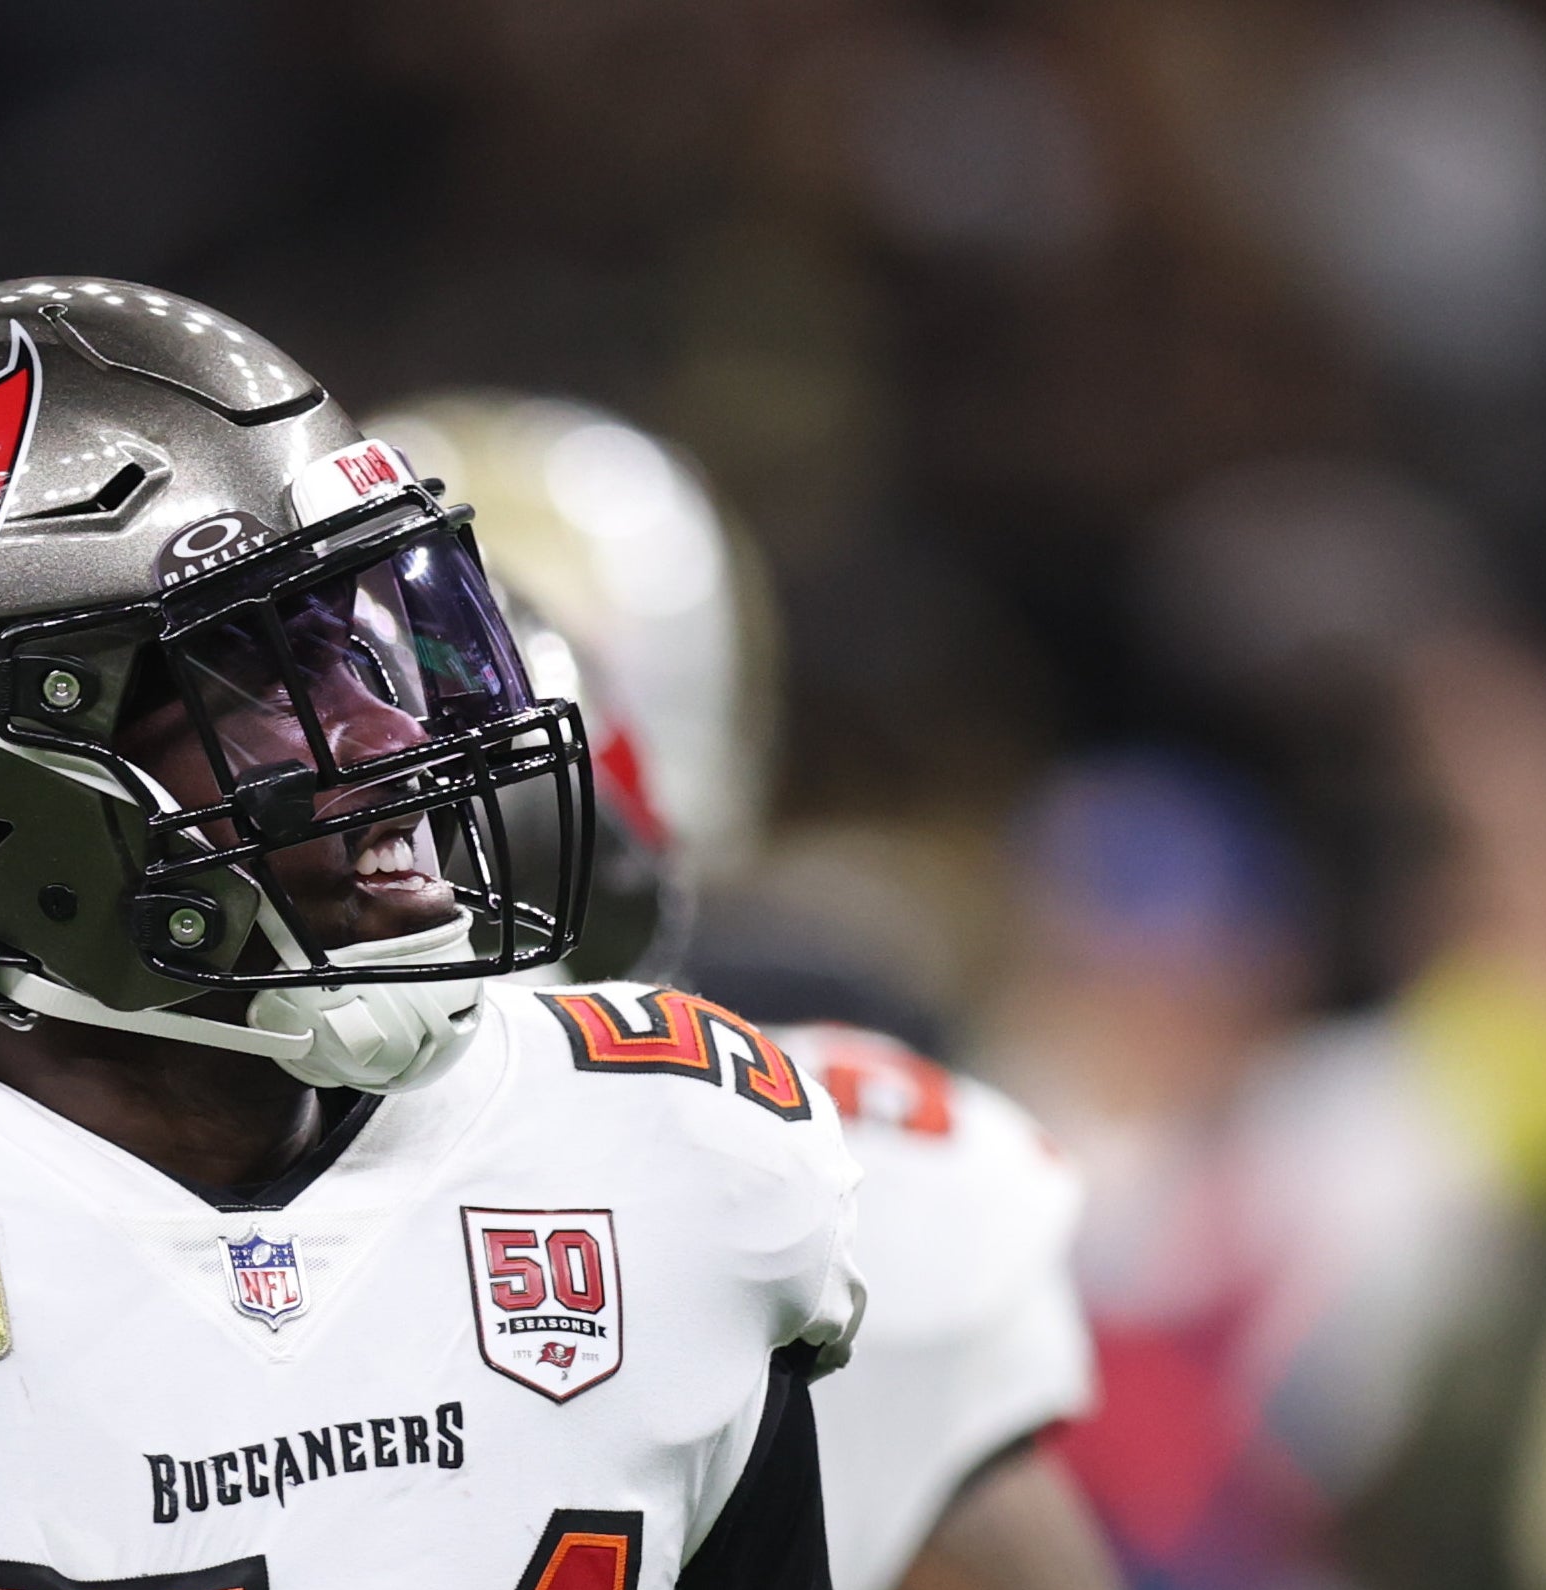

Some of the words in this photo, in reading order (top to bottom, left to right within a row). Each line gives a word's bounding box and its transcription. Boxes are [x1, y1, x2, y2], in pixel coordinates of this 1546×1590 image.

[163, 531, 267, 586] OAKLEY
[240, 1271, 298, 1309] NFL
[482, 1228, 605, 1315] 50
[514, 1319, 591, 1334] SEASONS
[143, 1401, 464, 1523] BUCCANEERS
